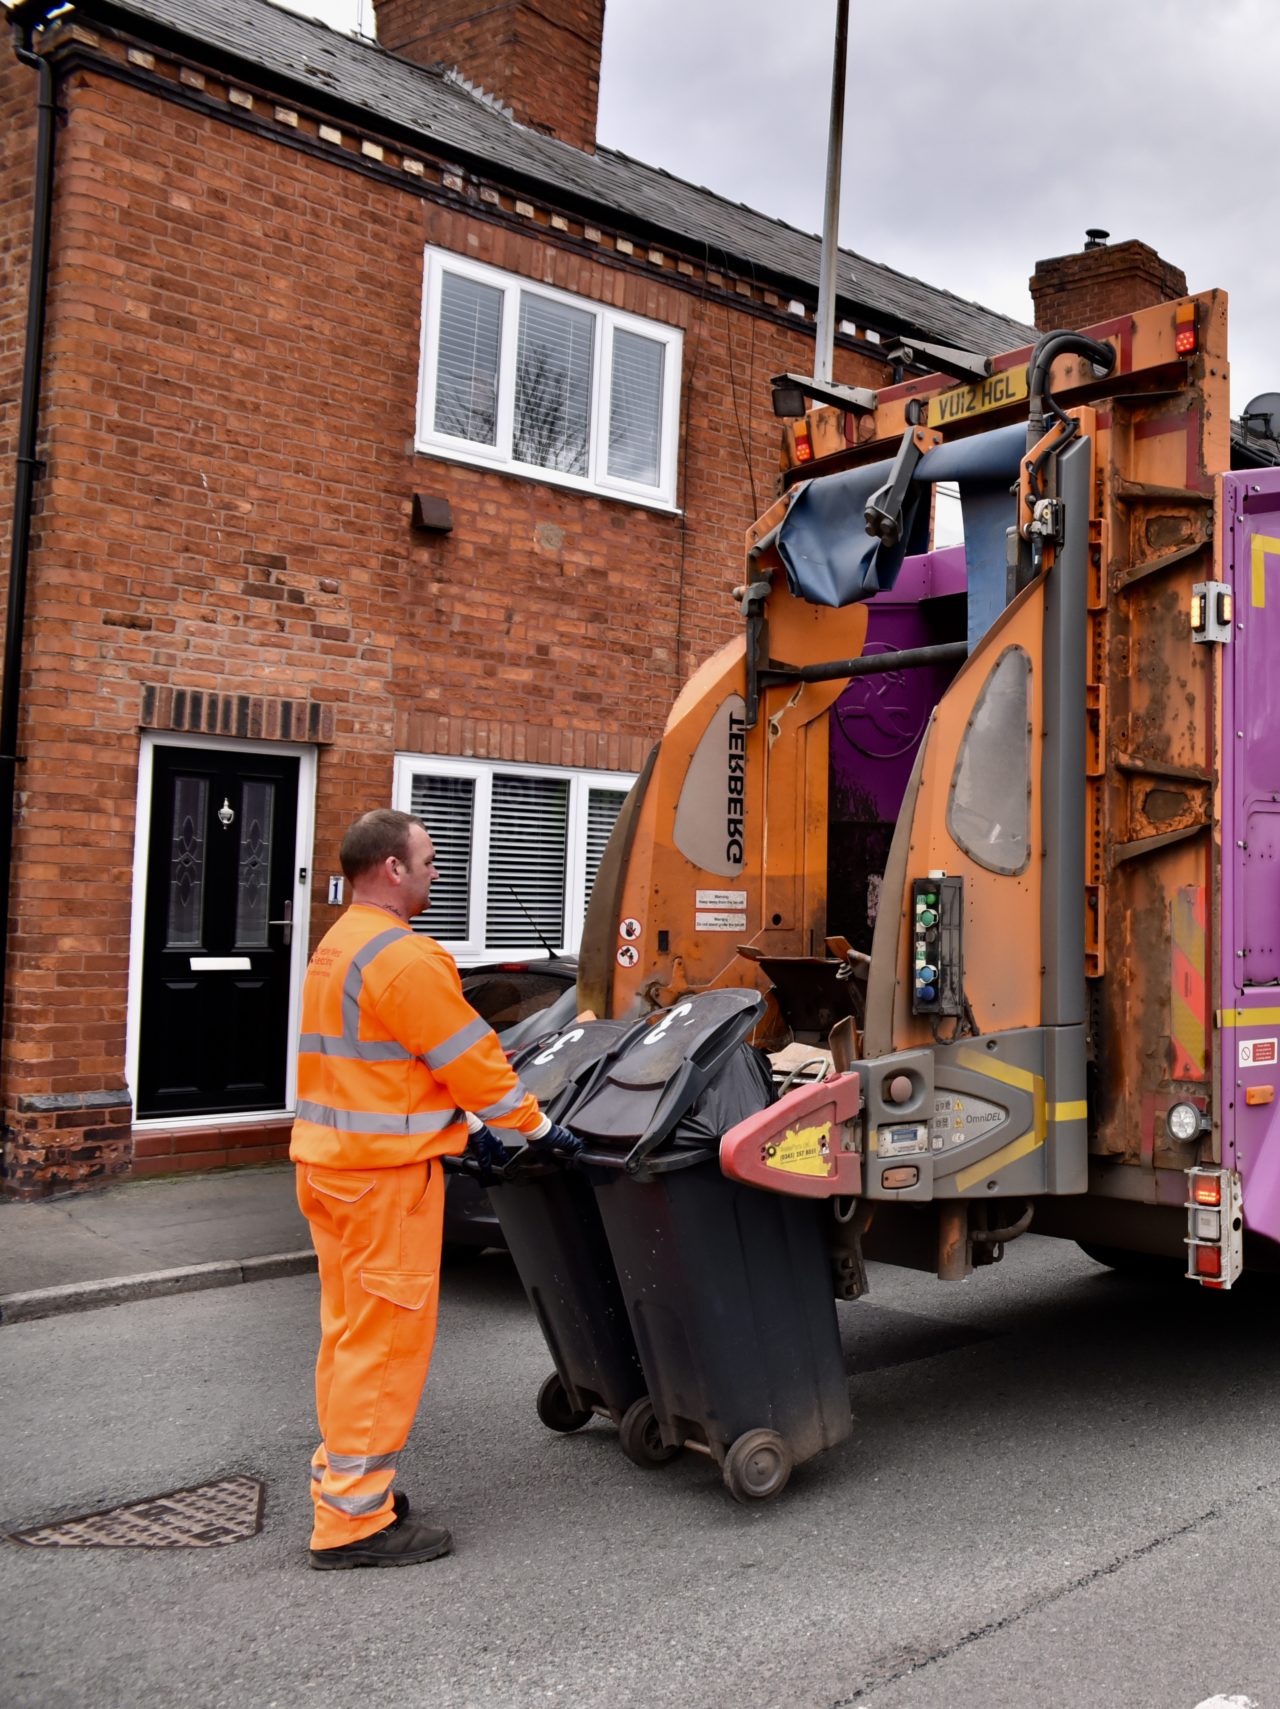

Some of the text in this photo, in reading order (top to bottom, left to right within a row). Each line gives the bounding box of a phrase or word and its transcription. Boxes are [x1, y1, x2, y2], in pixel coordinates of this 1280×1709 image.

[939, 376, 1016, 420] VU12 HGL
[966, 1112, 1002, 1124] OmniDEL
